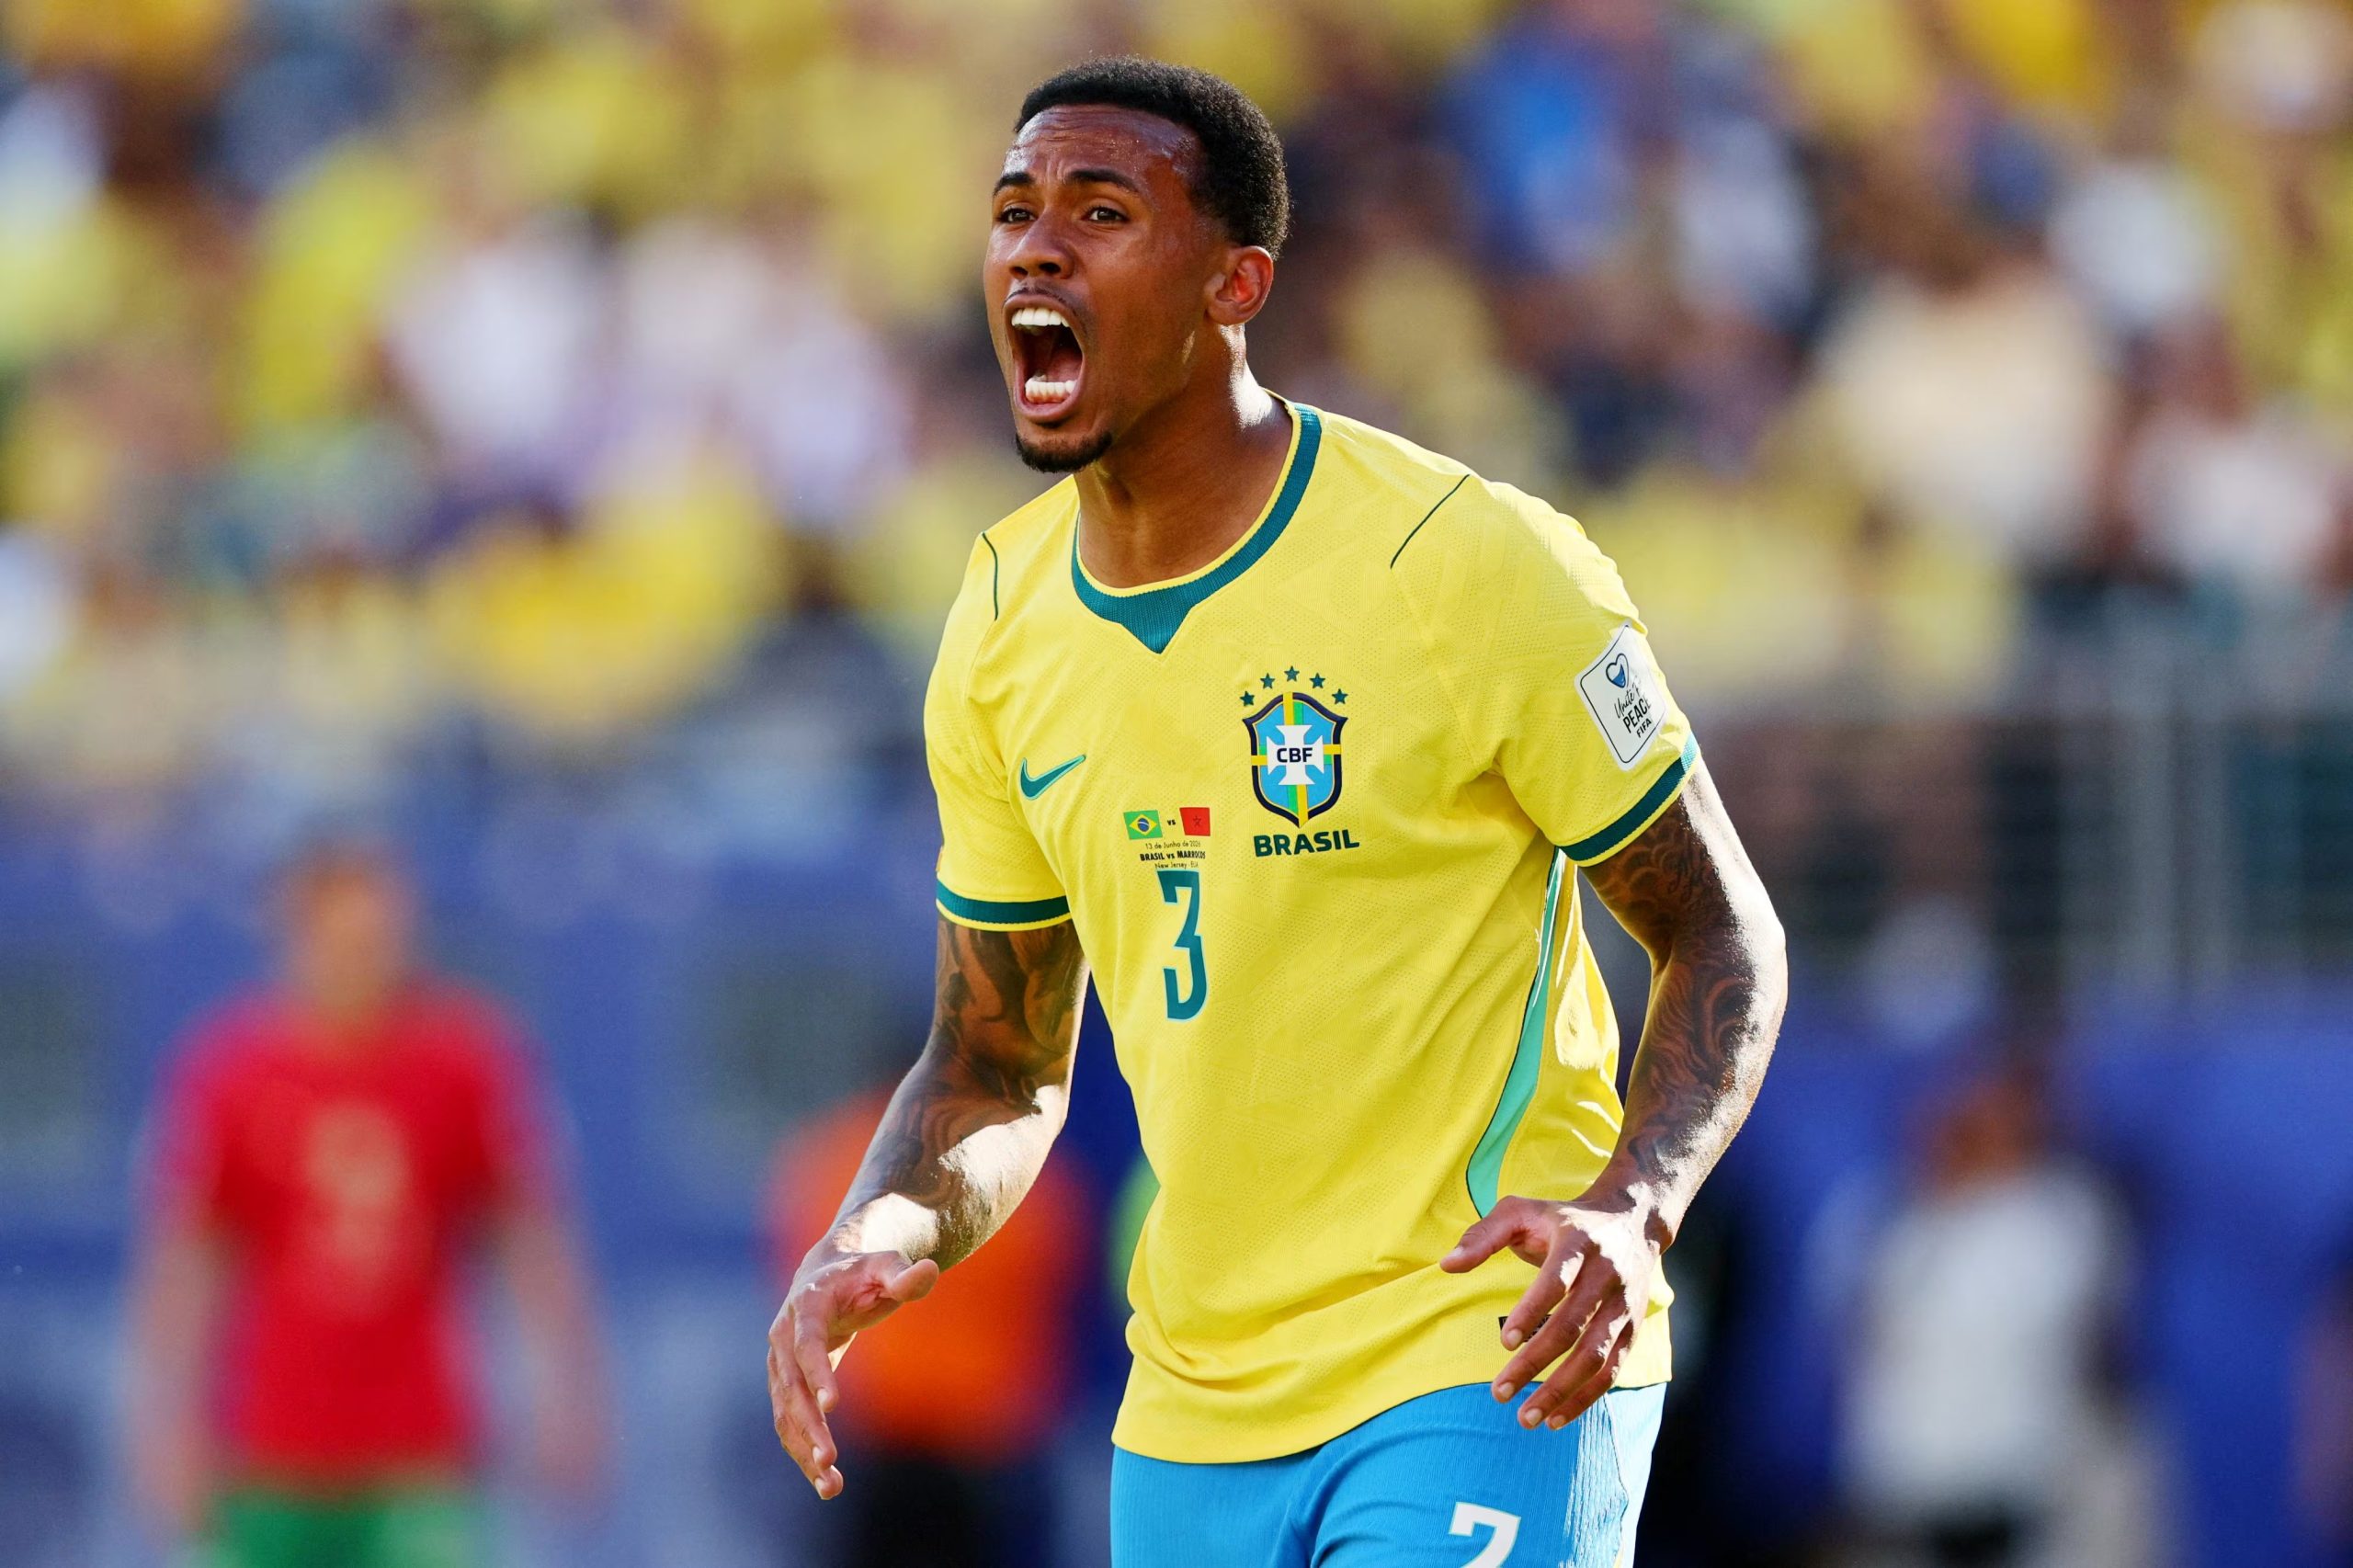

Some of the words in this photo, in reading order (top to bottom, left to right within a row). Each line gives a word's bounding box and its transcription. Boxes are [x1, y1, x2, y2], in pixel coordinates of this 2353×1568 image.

[1636, 718, 1652, 738] FIFA
[1276, 747, 1313, 763] CBF
[1164, 840, 1181, 848] Junho
[1253, 829, 1360, 858] BRASIL
[1140, 852, 1165, 861] BRASIL
[1176, 850, 1206, 859] MARROCOS
[1156, 869, 1208, 1021] 3
